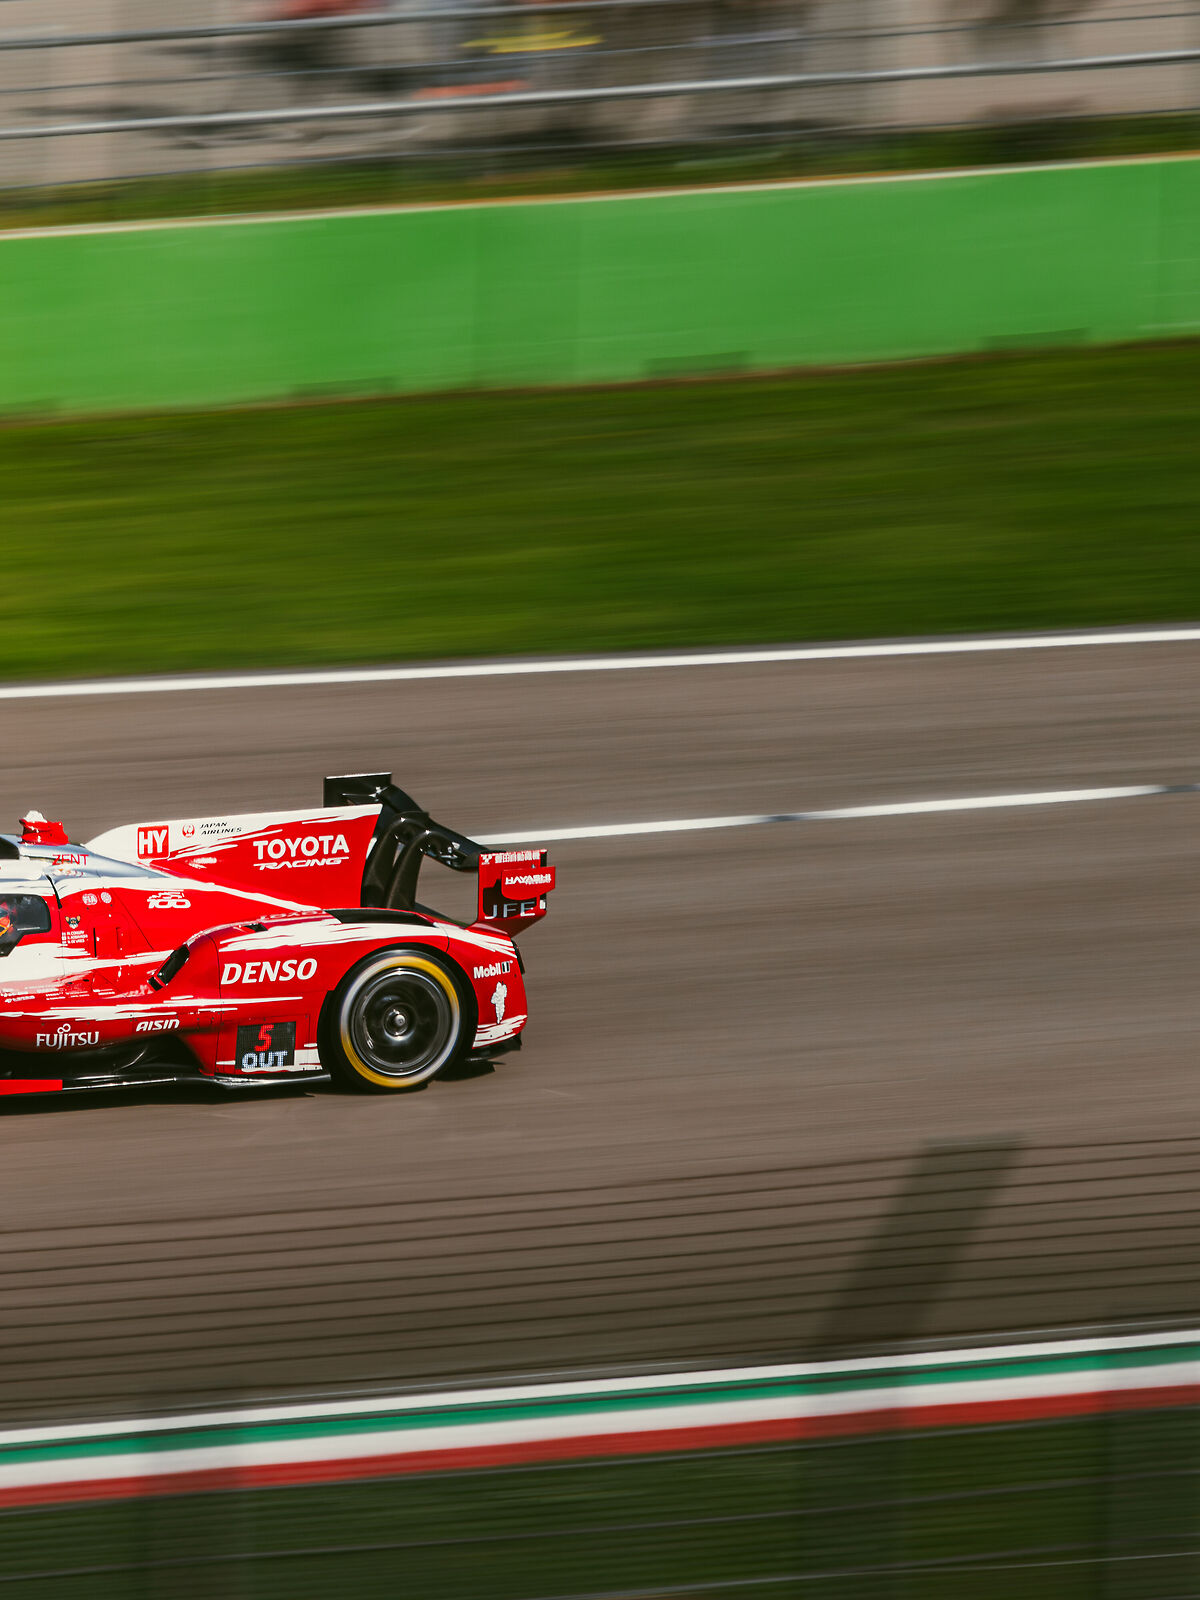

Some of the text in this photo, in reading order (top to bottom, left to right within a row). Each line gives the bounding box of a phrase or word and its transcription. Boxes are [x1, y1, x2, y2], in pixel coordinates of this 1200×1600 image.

[138, 829, 168, 855] HY
[252, 834, 350, 860] TOYOTA
[51, 853, 90, 866] ZENT
[252, 856, 350, 871] RACING
[484, 901, 536, 920] JFE
[220, 958, 318, 985] DENSO
[135, 1018, 180, 1032] AISIN
[36, 1028, 100, 1049] FUJITSU
[253, 1024, 275, 1052] 5
[241, 1050, 288, 1069] OUT
